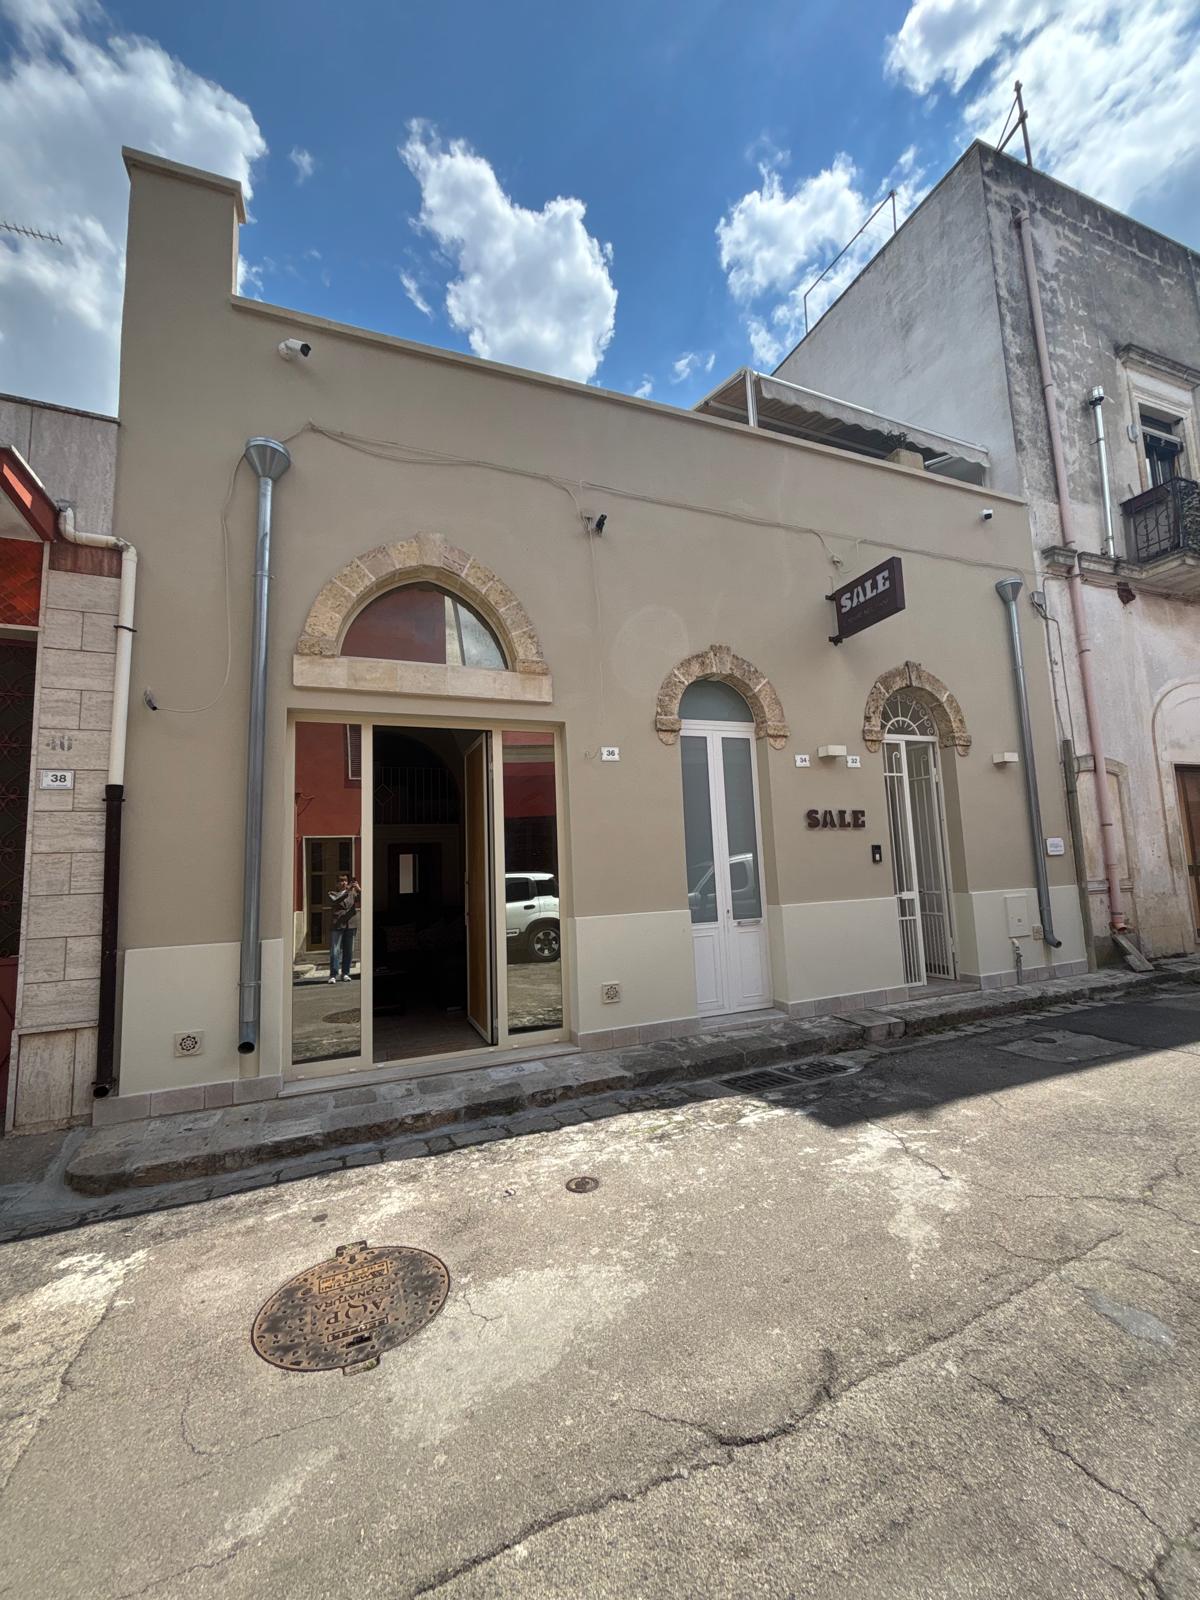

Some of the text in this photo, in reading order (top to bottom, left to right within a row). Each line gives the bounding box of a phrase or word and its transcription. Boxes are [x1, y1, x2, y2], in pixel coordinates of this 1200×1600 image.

[840, 569, 890, 613] SALE
[50, 773, 67, 783] 38
[806, 809, 866, 829] SALE
[314, 1283, 391, 1310] FOGNATURA
